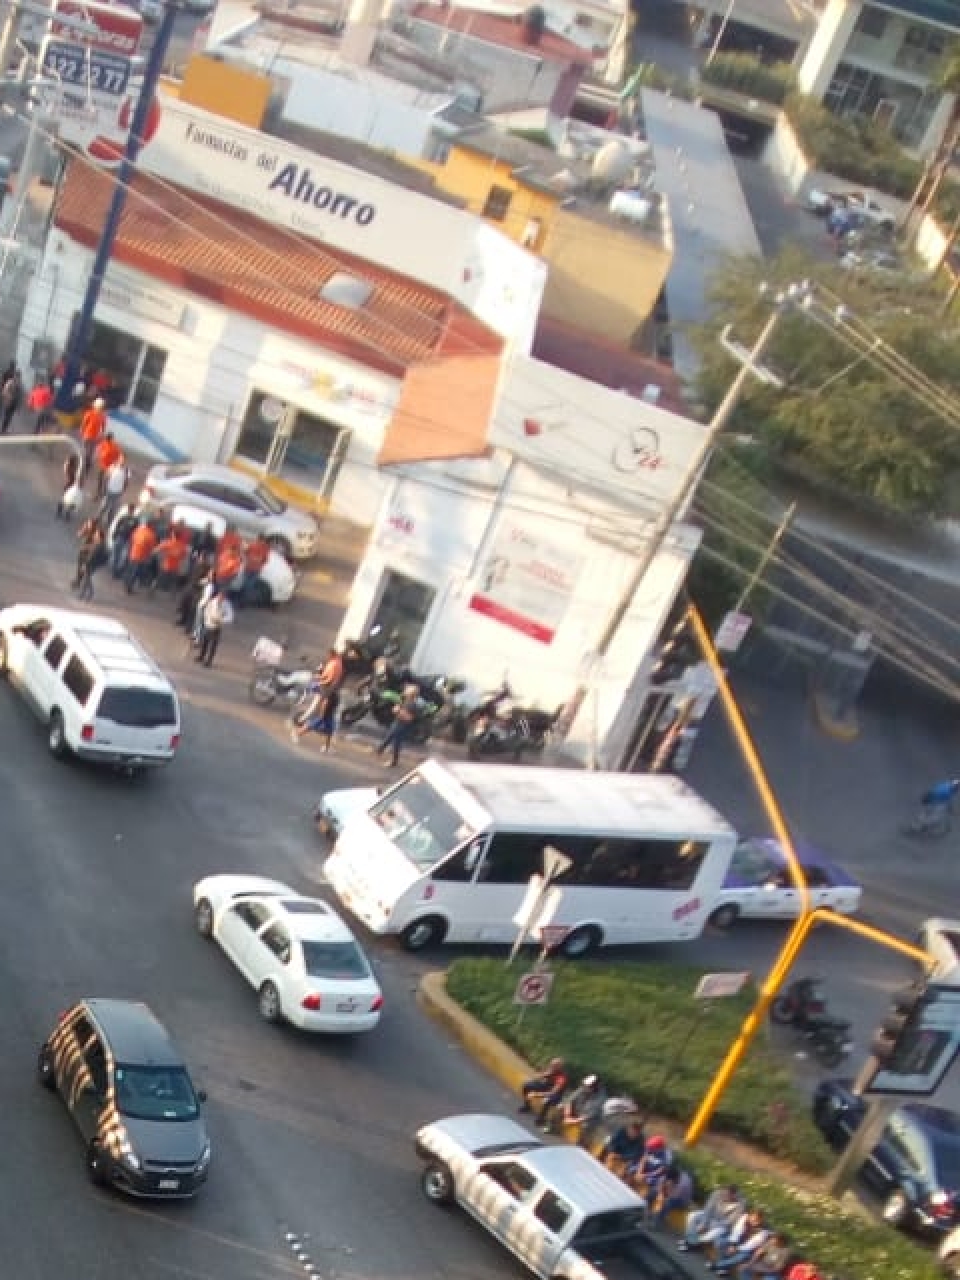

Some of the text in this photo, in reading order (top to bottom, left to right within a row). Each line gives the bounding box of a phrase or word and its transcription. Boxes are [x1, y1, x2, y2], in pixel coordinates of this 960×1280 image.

[185, 121, 280, 173] Farmacias del
[268, 160, 377, 227] Ahorro
